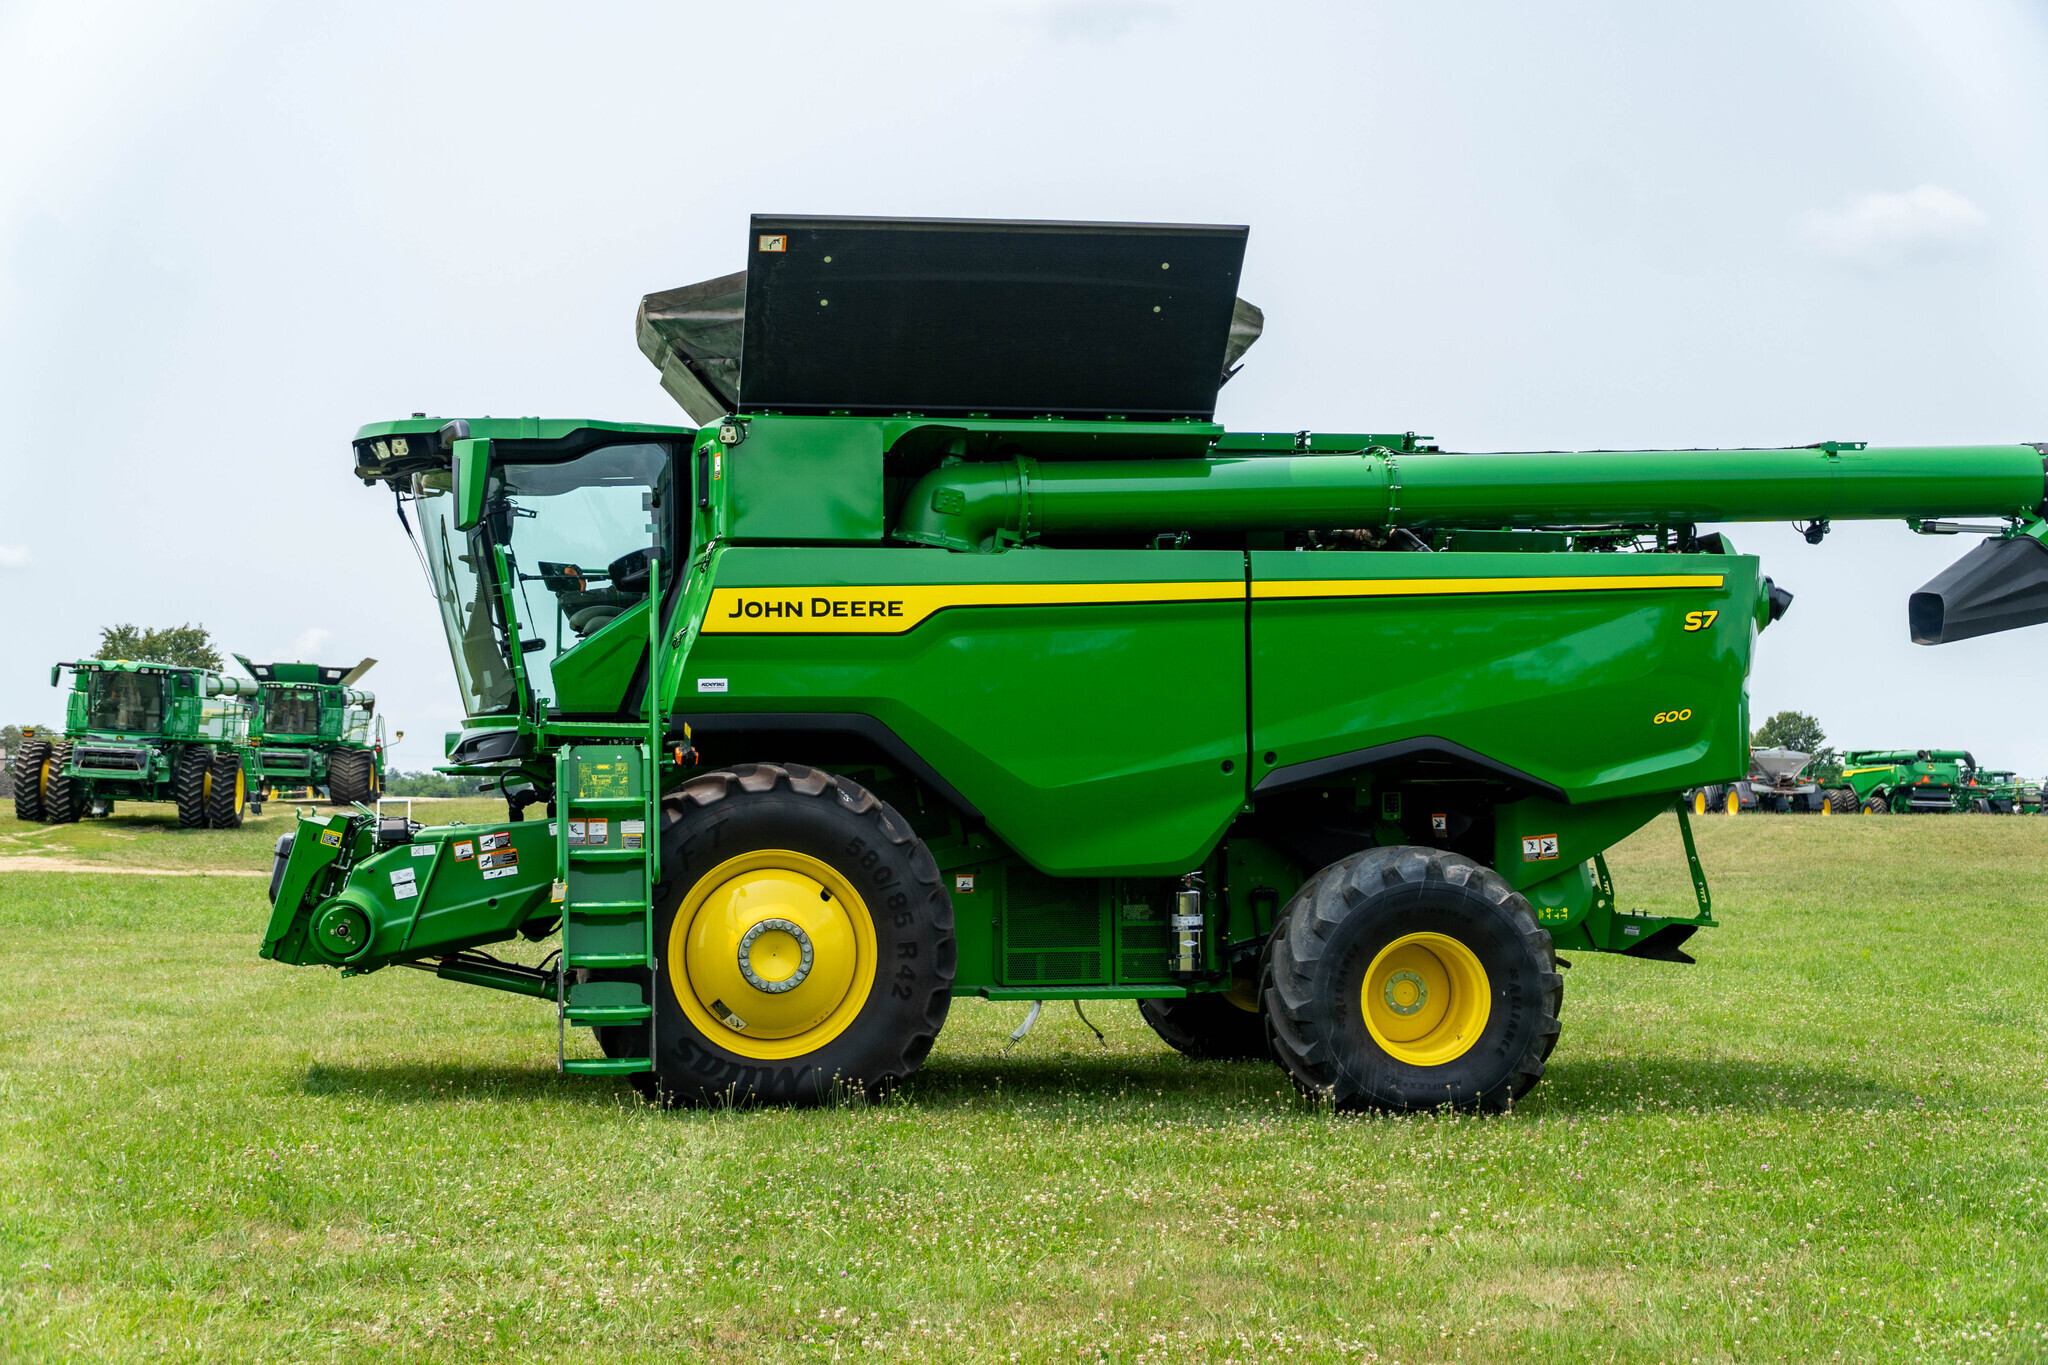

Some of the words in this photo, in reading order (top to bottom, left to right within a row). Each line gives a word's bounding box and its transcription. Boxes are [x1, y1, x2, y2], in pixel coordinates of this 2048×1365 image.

[729, 598, 803, 618] JOHN
[812, 597, 903, 617] DEERE
[1684, 610, 1719, 632] S7
[1653, 708, 1692, 725] 600
[1495, 982, 1522, 1058] ALLIANCE
